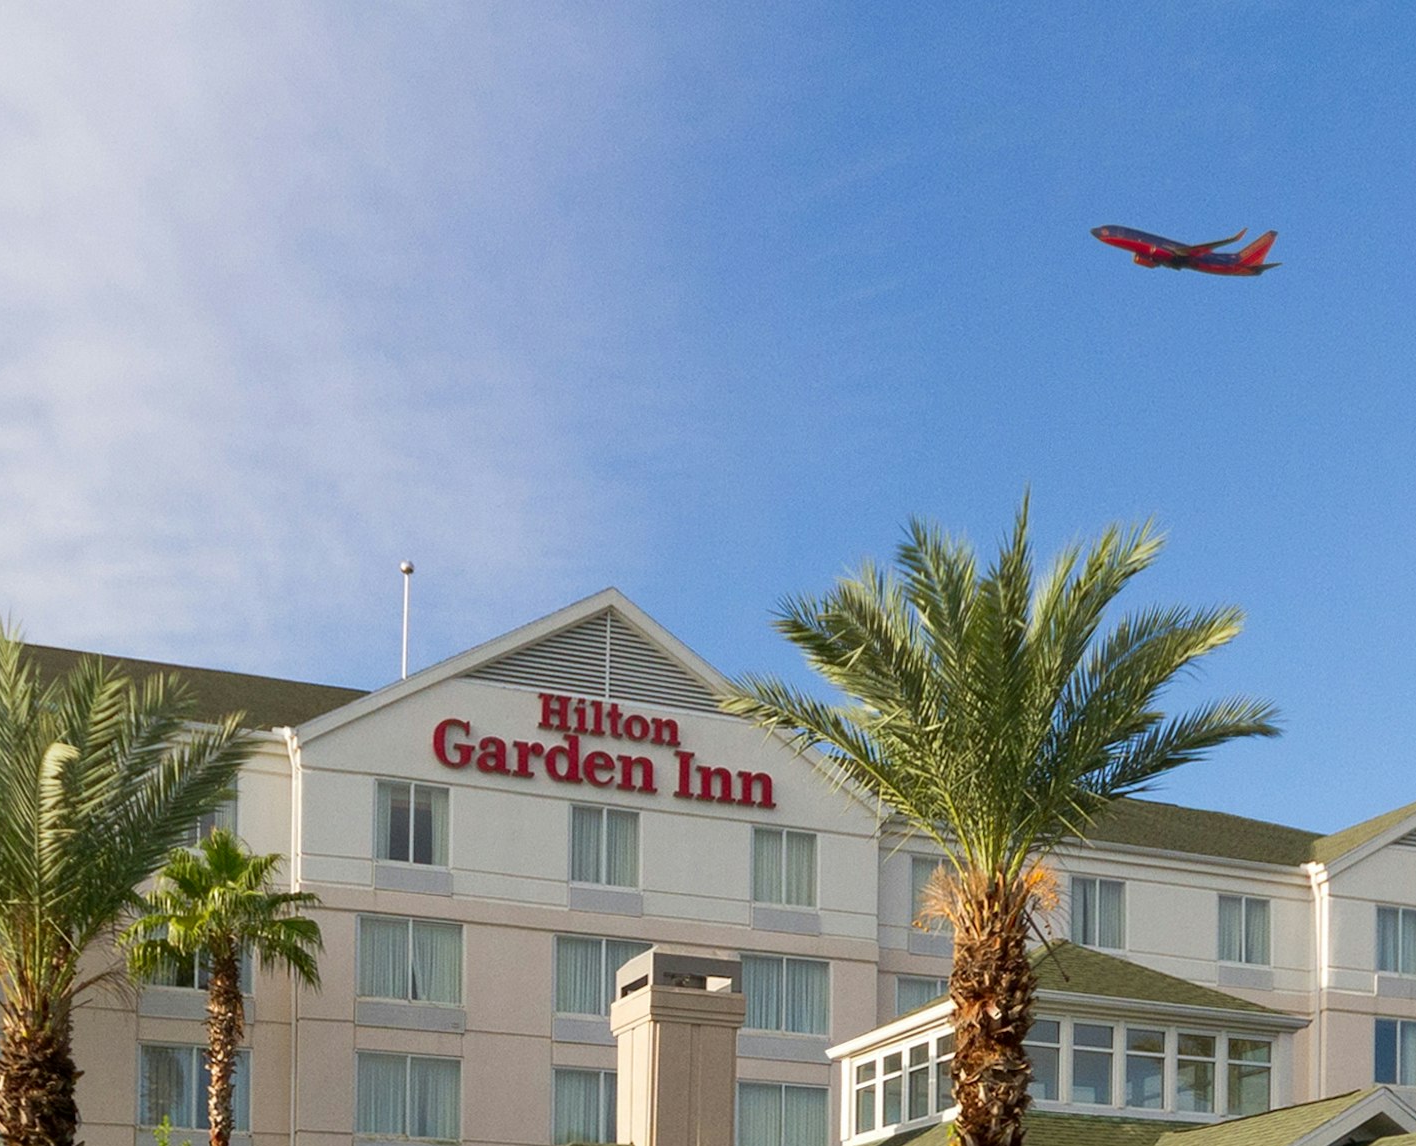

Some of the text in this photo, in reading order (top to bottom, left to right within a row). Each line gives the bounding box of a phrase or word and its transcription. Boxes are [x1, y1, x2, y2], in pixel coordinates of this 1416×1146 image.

[538, 693, 681, 747] Hilton
[432, 718, 777, 810] Garden Inn
